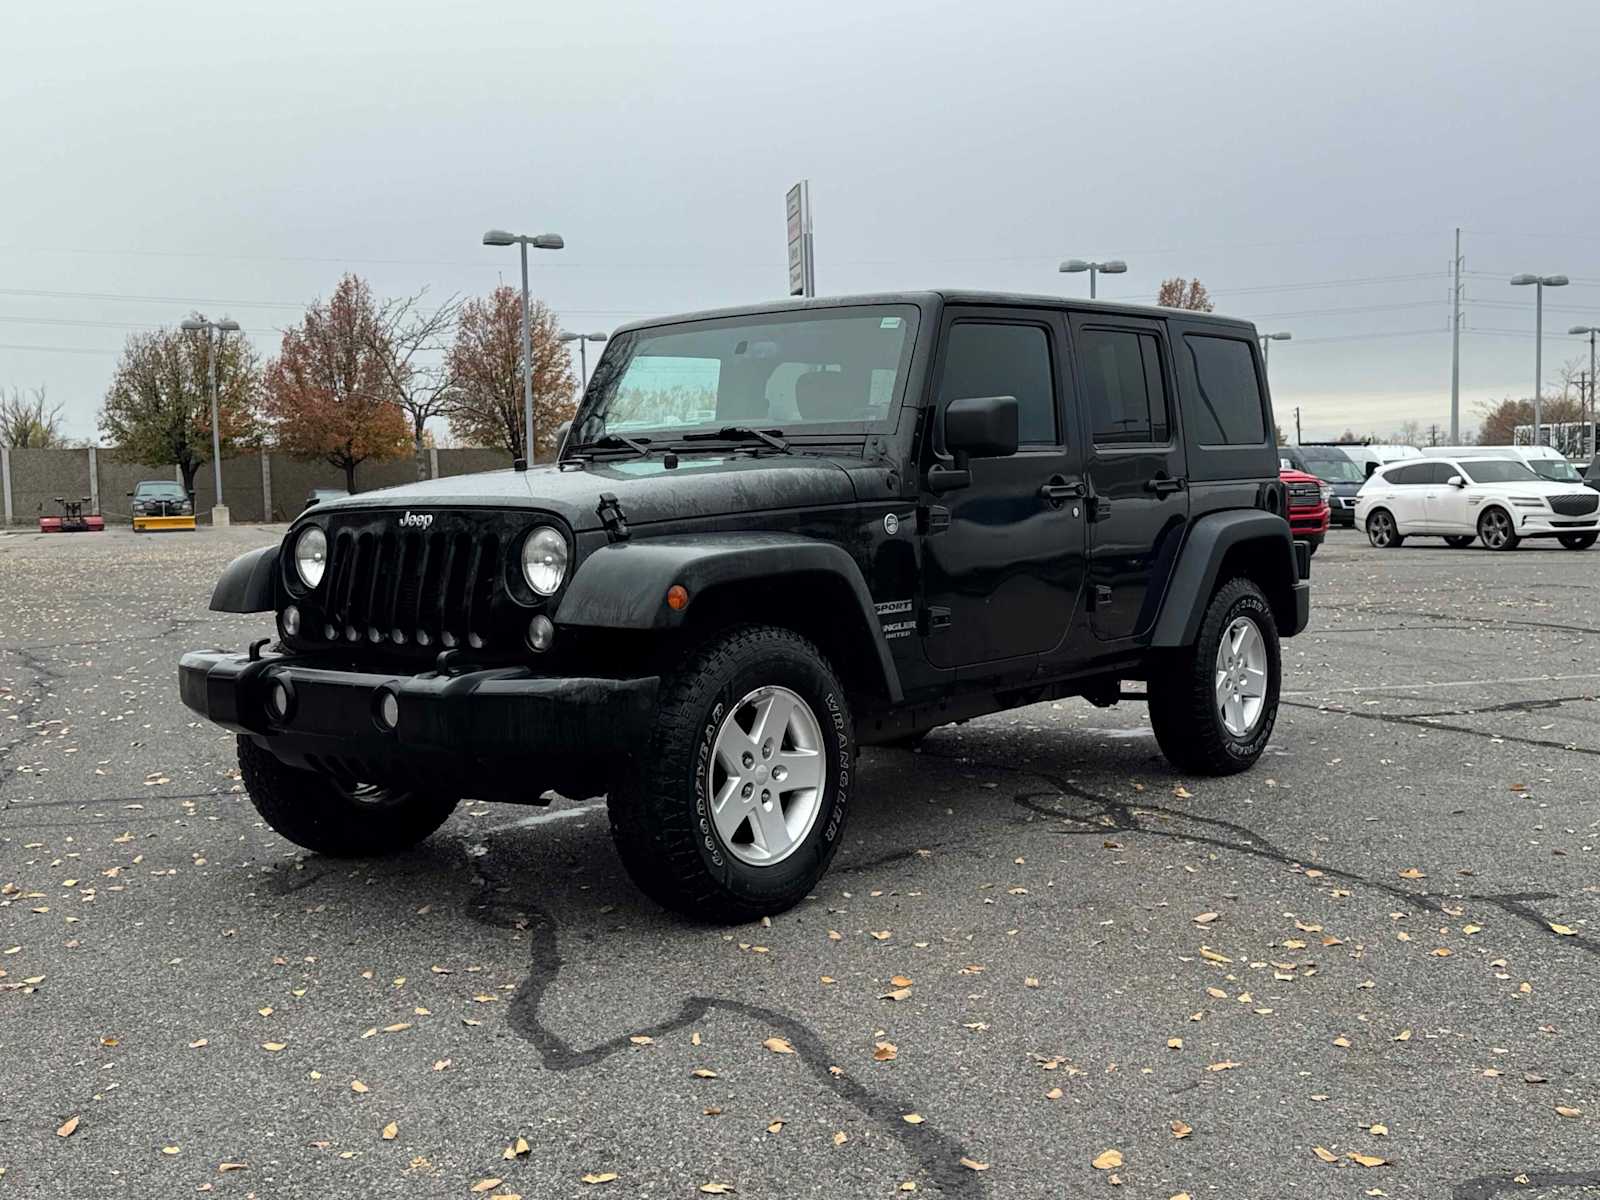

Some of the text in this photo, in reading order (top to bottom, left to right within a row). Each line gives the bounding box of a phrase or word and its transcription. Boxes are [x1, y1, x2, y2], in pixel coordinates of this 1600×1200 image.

[399, 511, 433, 530] Jeep
[874, 601, 910, 613] SPORT
[825, 693, 849, 842] WRANGLER
